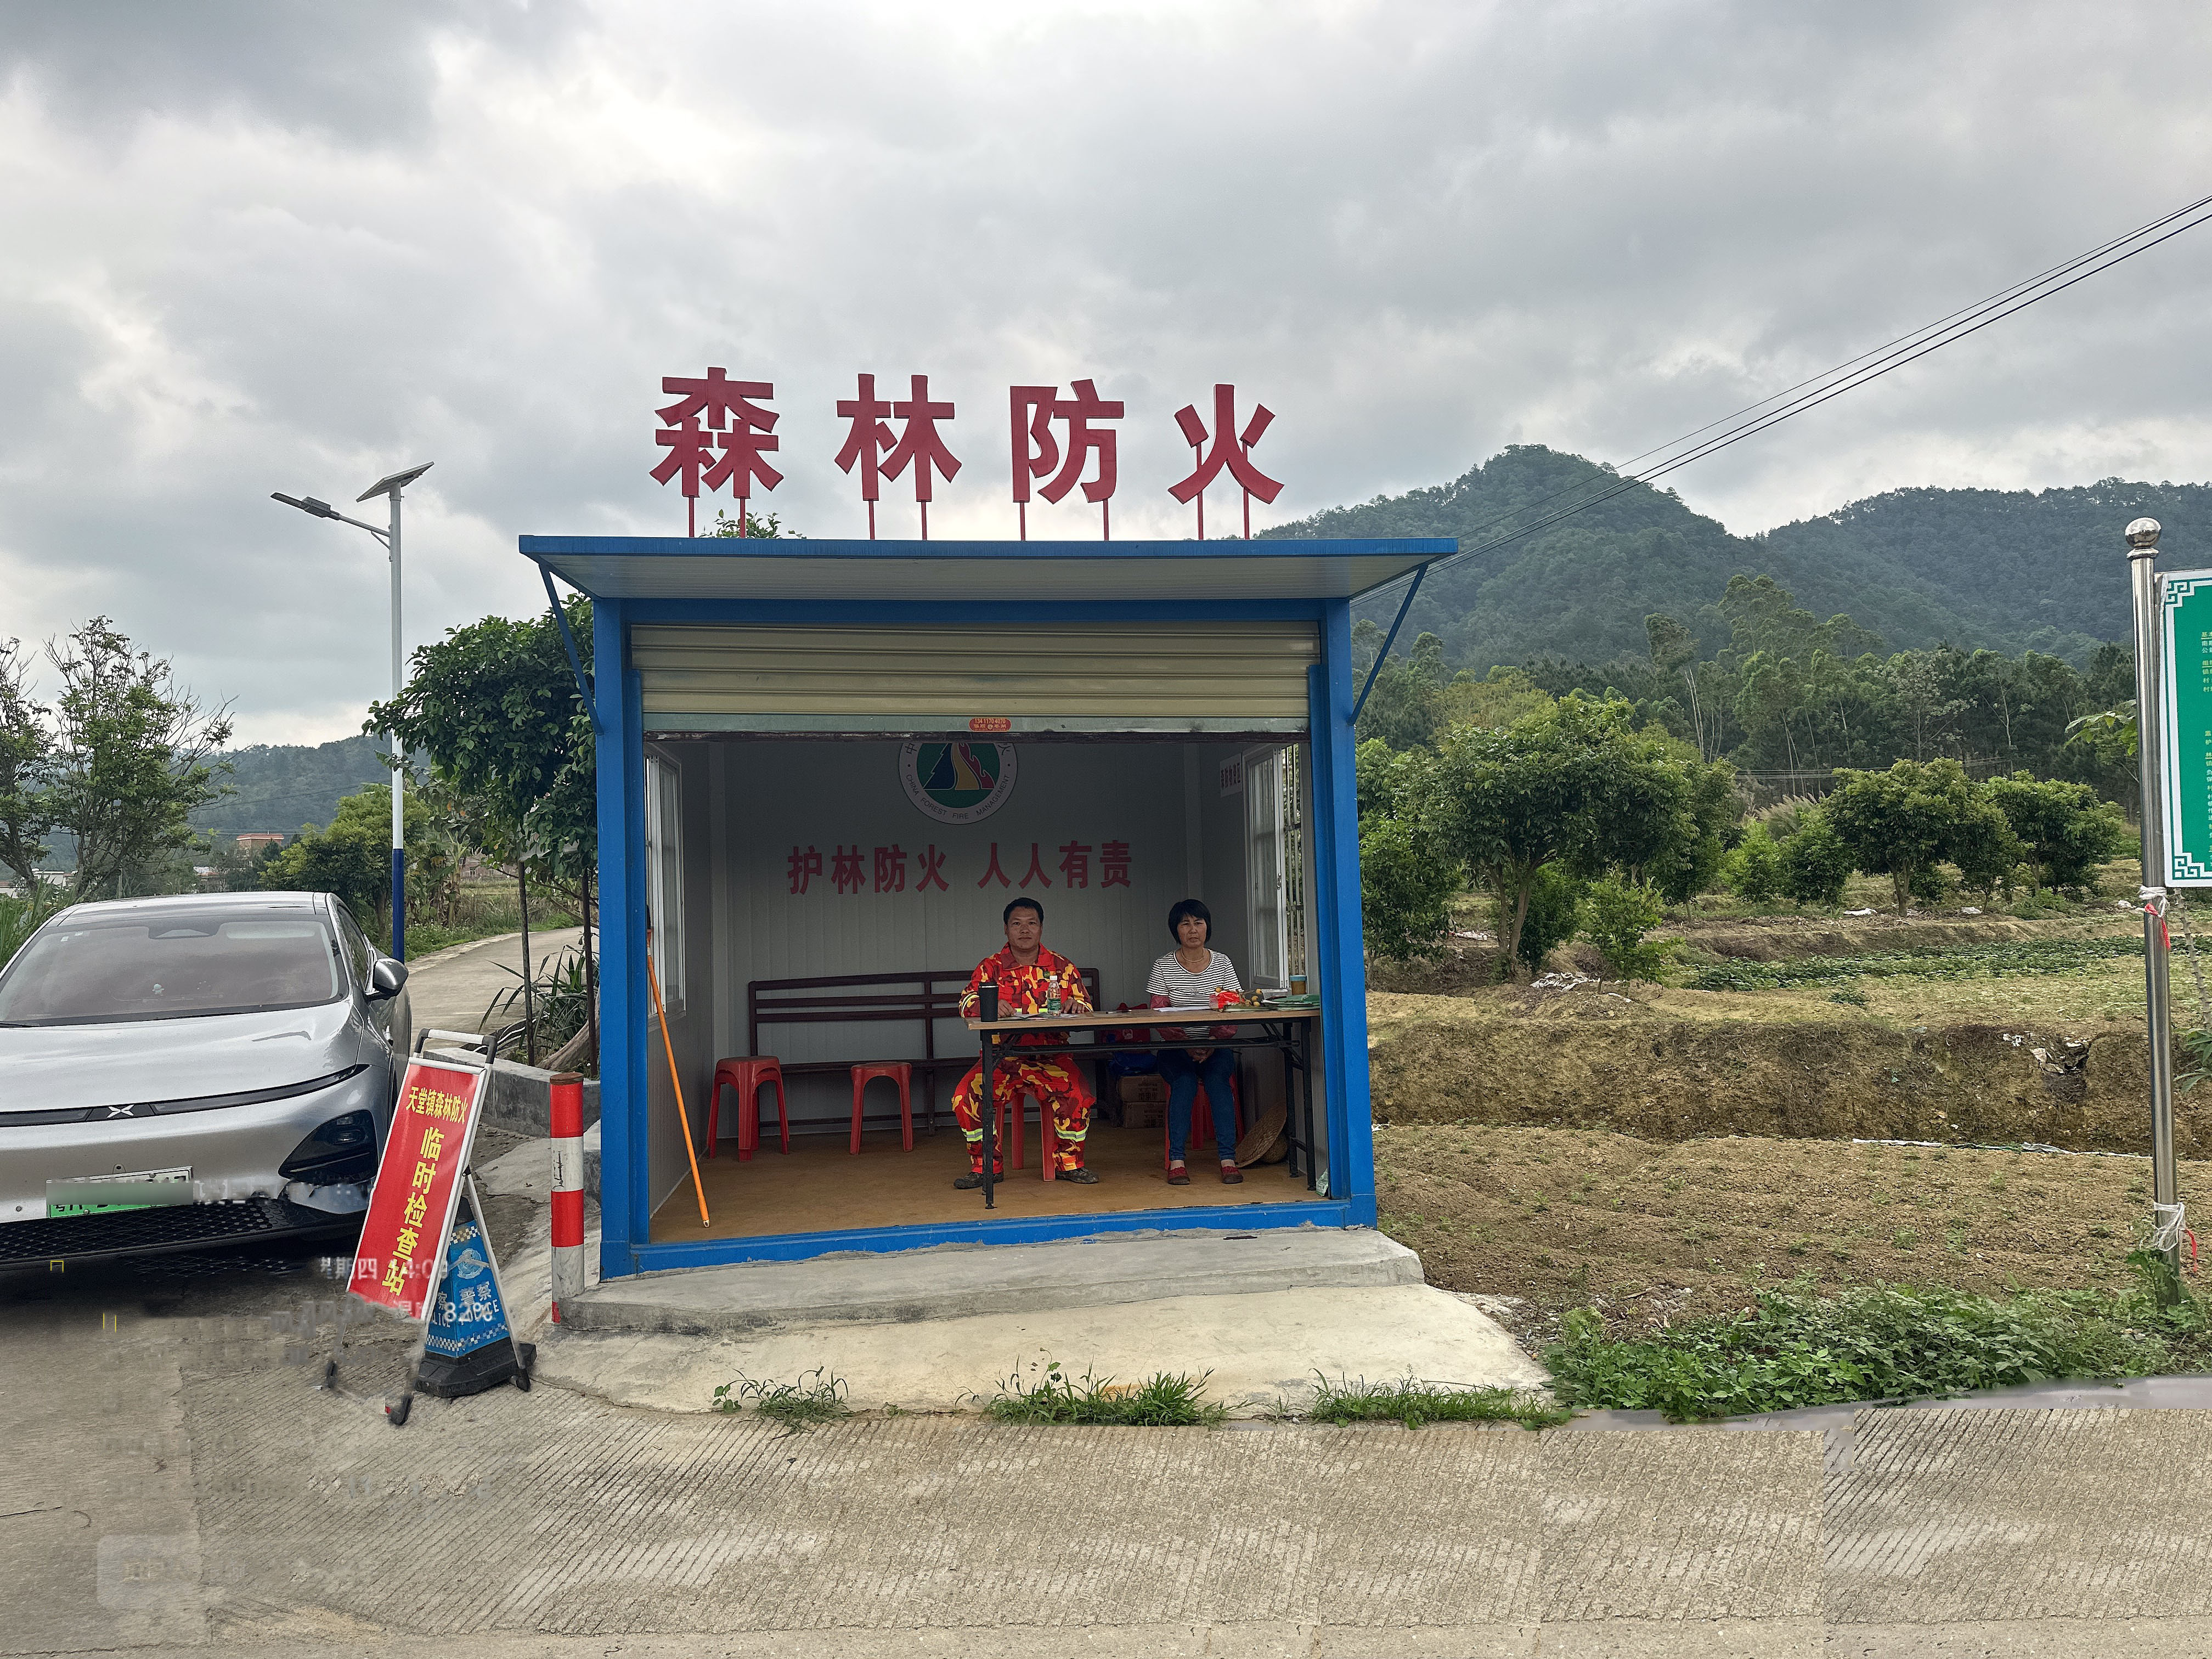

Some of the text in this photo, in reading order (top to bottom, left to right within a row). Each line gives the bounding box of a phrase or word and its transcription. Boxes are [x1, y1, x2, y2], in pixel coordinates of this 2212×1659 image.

[650, 366, 1284, 506] 森林防火
[906, 774, 919, 796] CHINA
[921, 797, 948, 816] FOREST
[975, 775, 1010, 816] MANAGEMENT
[787, 839, 1132, 895] 护林防火 人人有责
[405, 1086, 469, 1125] 天堂镇森林防火
[381, 1126, 445, 1296] 临时检查站
[459, 1280, 492, 1306] 警察
